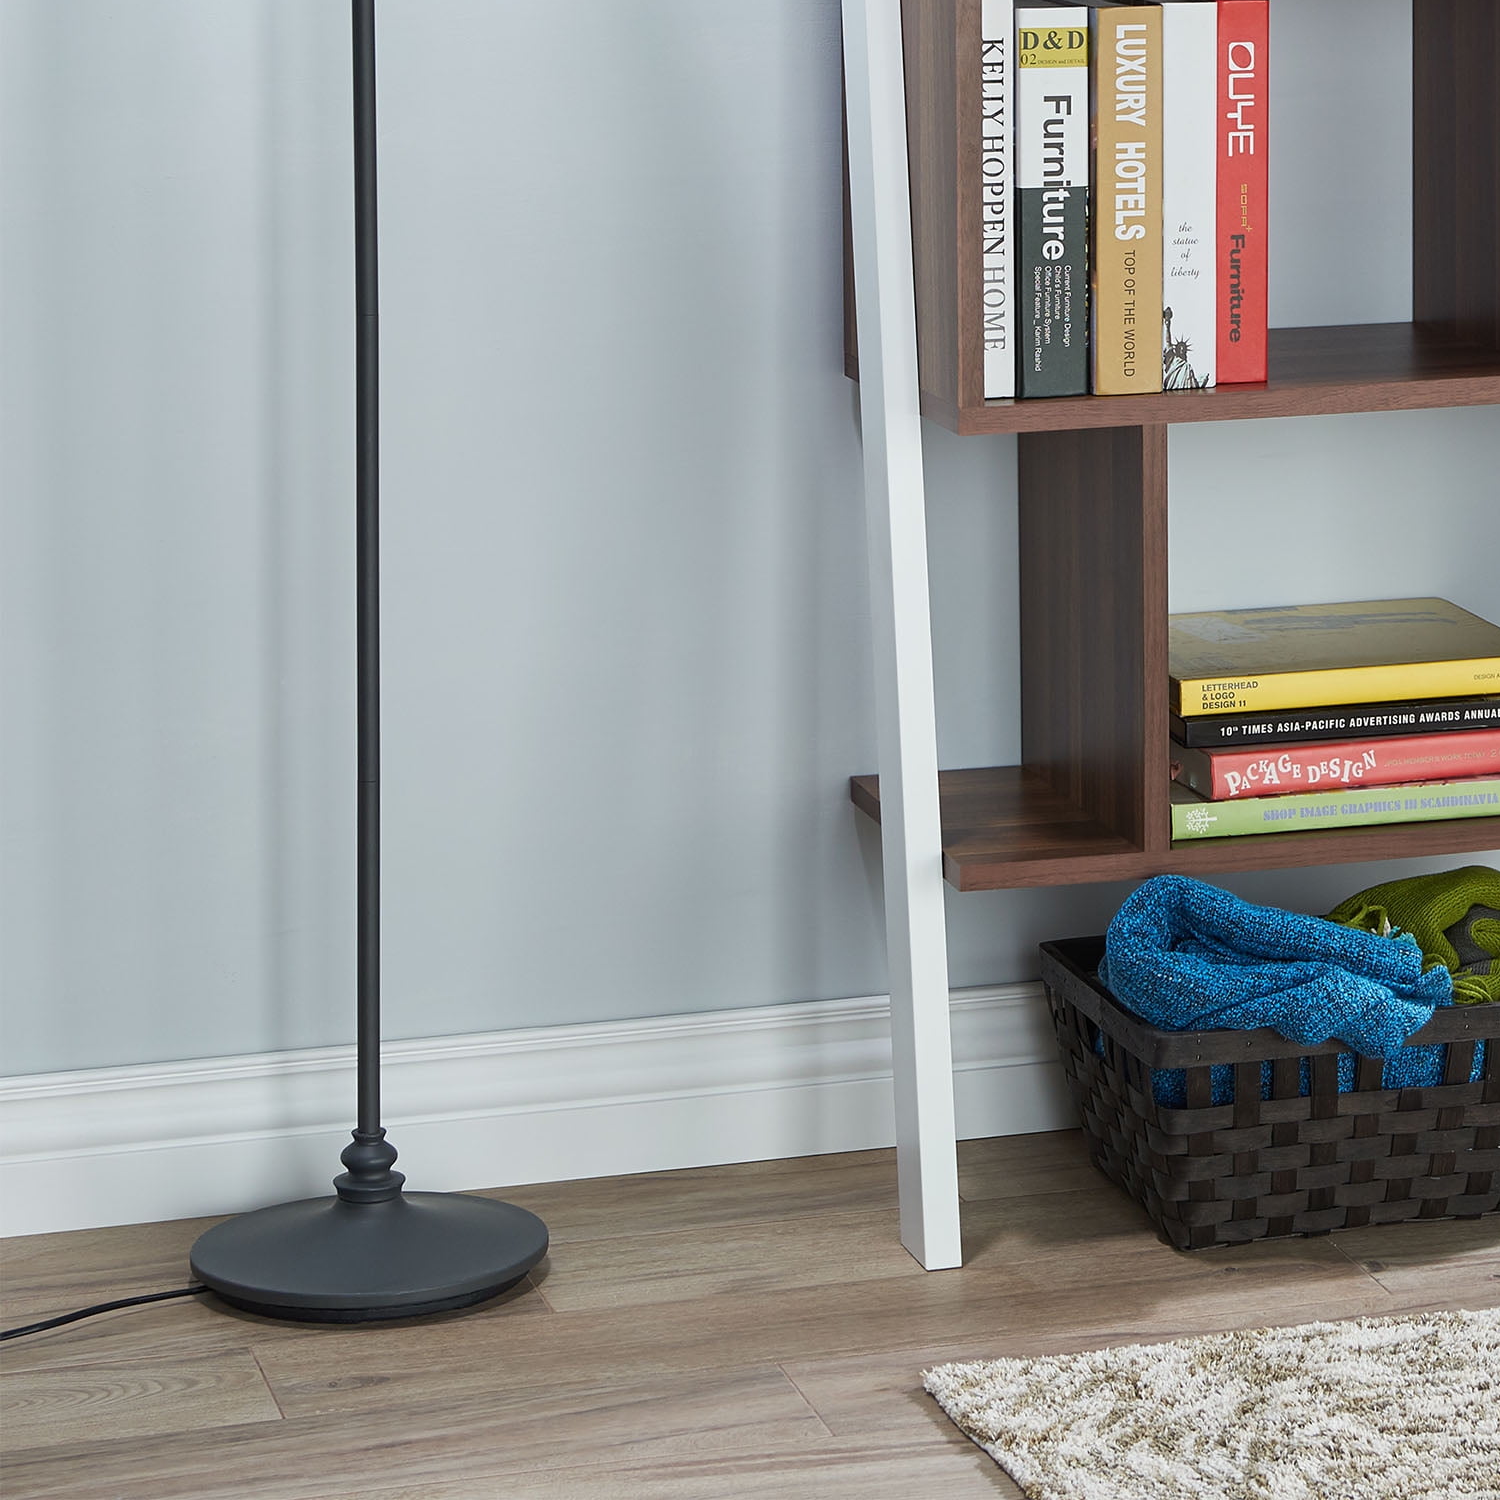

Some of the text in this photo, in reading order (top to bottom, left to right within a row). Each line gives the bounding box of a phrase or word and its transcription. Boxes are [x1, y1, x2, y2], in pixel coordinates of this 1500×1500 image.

[1022, 30, 1084, 50] D & D
[1021, 54, 1036, 65] 02
[1042, 95, 1072, 260] Furniture
[982, 38, 1006, 351] KELLY HOPPEN HOME
[1115, 24, 1147, 377] LUXURY HOTELS TOP OF THE WORLD
[1178, 222, 1192, 233] the
[1172, 237, 1199, 246] statue
[1180, 249, 1191, 262] of
[1034, 266, 1042, 291] Special
[1064, 265, 1072, 291] Current
[1171, 267, 1200, 279] liberty
[1229, 234, 1245, 343] Furniture
[1034, 292, 1042, 319] Feature
[1043, 266, 1052, 344] Office Furniture System
[1054, 289, 1062, 320] Furniture
[1034, 326, 1042, 347] Karim
[1063, 323, 1071, 347] Design
[1034, 347, 1042, 372] Rashid
[1202, 681, 1258, 692] LETTERHEAD
[1202, 692, 1235, 701] & LOGO
[1202, 700, 1246, 710] DESIGN 11
[1241, 723, 1273, 735] TIMES
[1277, 718, 1346, 733] ASIA-PACIFIC
[1350, 713, 1416, 728] ADVERTISING
[1419, 710, 1460, 723] AWARDS
[1224, 754, 1302, 796] PACKAGE
[1307, 749, 1377, 783] DESIGN
[1300, 804, 1338, 818] IMAGE
[1341, 799, 1401, 815] GRAPHICS
[1404, 797, 1417, 810] IN
[1420, 792, 1499, 810] SCANDINAVIA
